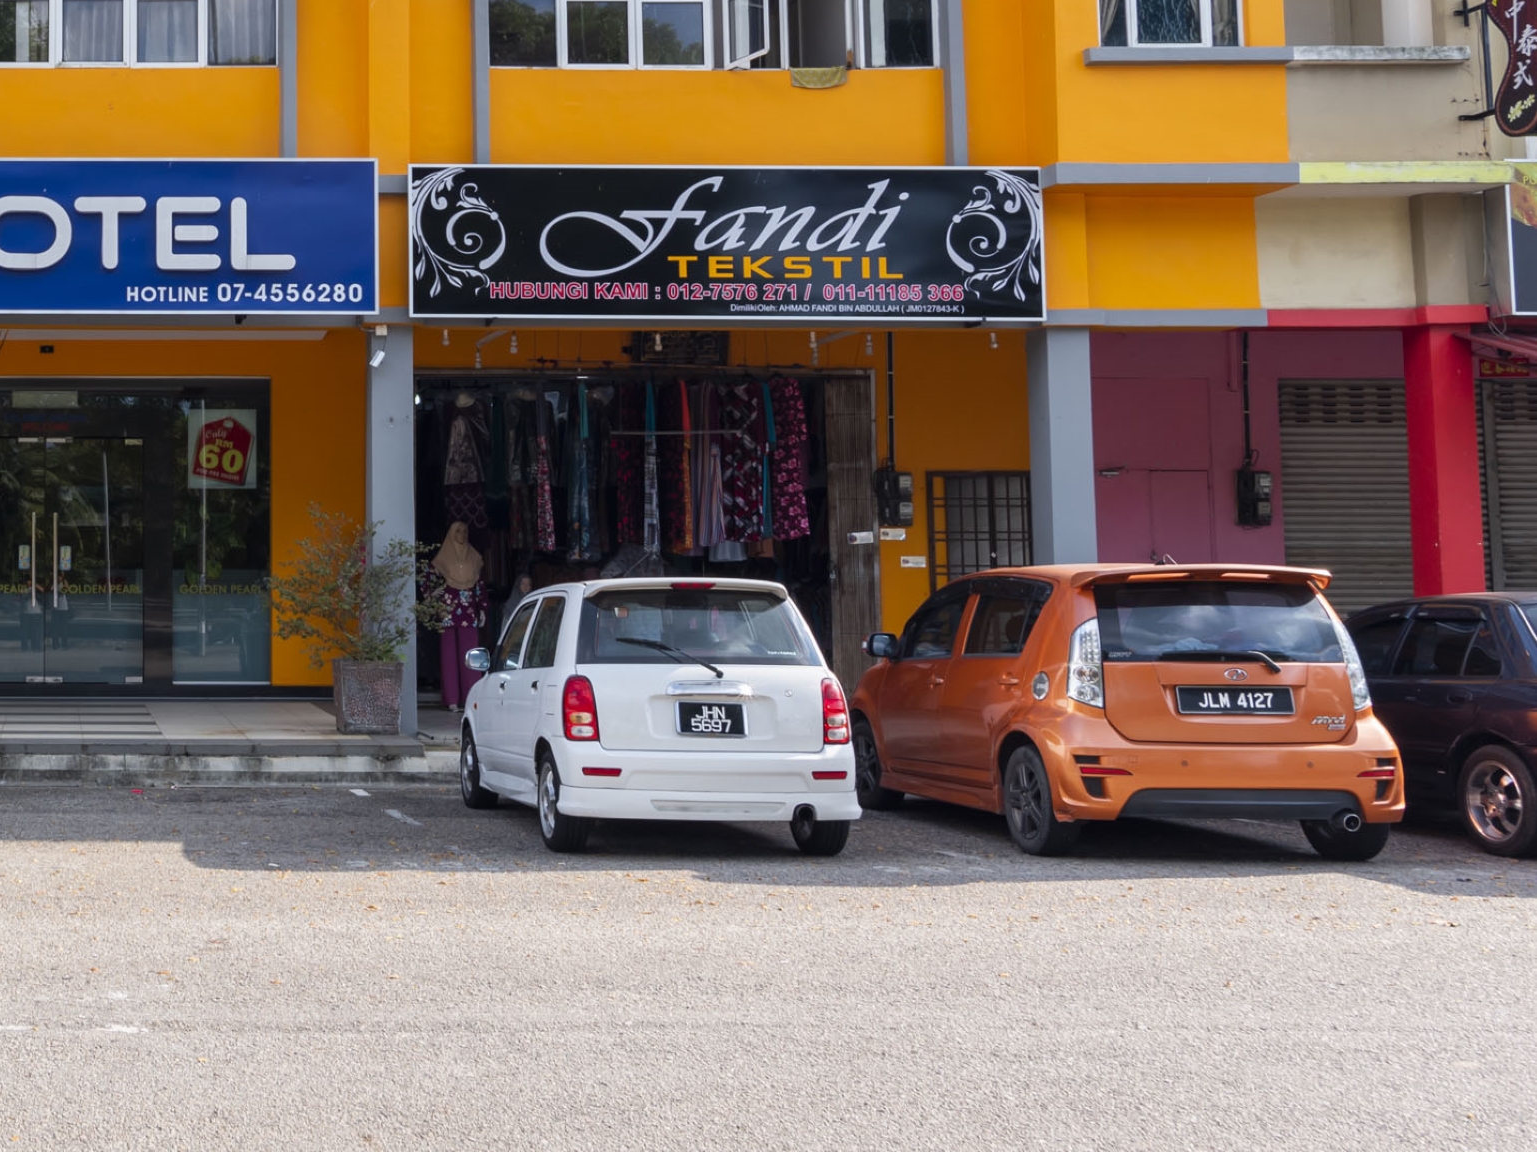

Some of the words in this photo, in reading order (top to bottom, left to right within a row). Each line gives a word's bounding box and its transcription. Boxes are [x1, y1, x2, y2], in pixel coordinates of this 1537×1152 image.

[667, 256, 904, 279] TEKSTIL
[126, 286, 208, 303] HOTLINE
[217, 283, 363, 303] 07-4556280
[489, 282, 588, 299] HUBUNGI
[594, 282, 648, 300] KAMI
[666, 283, 758, 301] 012-7576
[762, 284, 798, 301] 271
[822, 284, 923, 302] 011-11185
[927, 285, 965, 302] 366
[779, 304, 810, 312] AHMAD
[811, 304, 837, 312] FANDI
[839, 304, 853, 312] BIN
[854, 304, 900, 313] ABDULLAH
[198, 443, 244, 474] 60
[60, 584, 106, 594] GOLDEN
[111, 584, 142, 594] PEARL
[179, 584, 227, 594] GOLDEN
[1198, 693, 1230, 708] JLM
[1237, 693, 1273, 708] 4127
[695, 705, 725, 719] JHN
[691, 718, 731, 733] 5697
